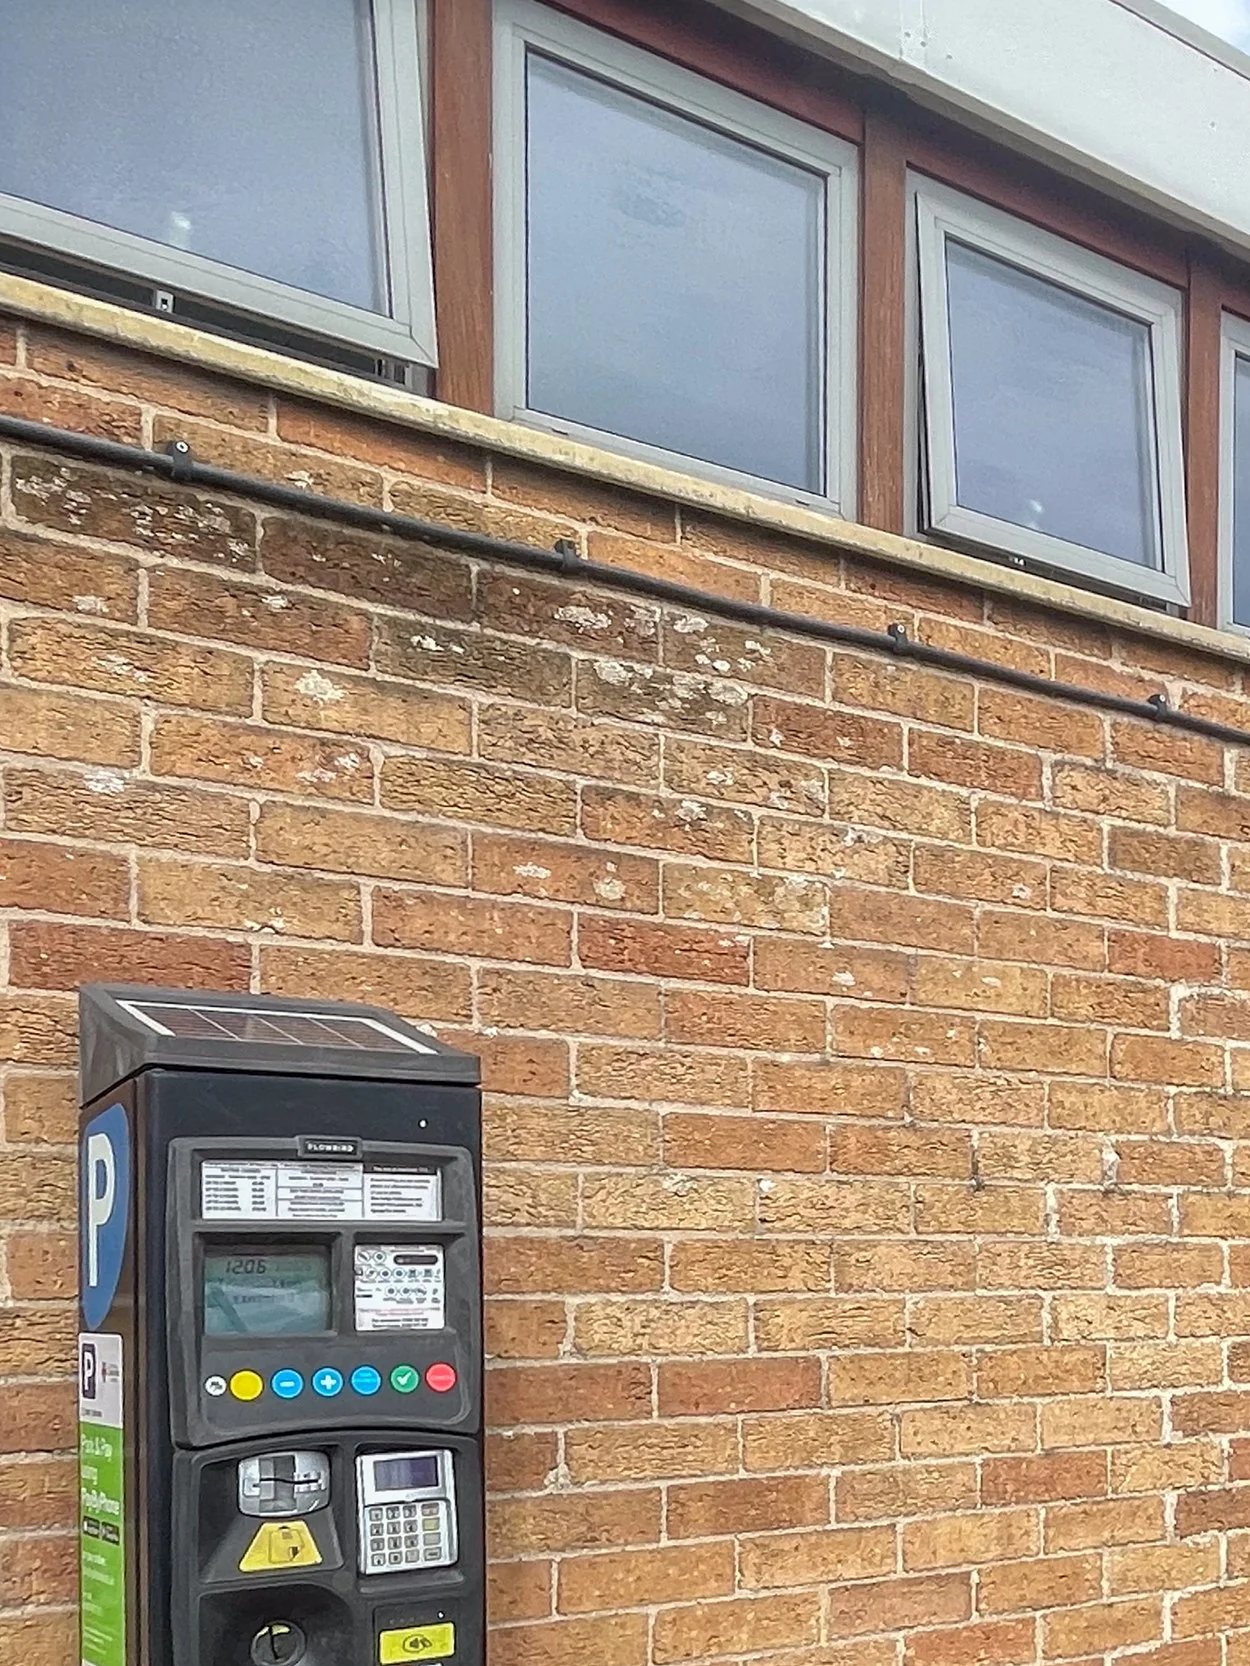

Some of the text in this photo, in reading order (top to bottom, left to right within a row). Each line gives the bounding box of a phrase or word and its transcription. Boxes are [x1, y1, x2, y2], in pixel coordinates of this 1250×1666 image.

[87, 1132, 115, 1288] P
[225, 1258, 267, 1275] 1206
[84, 1351, 94, 1391] P
